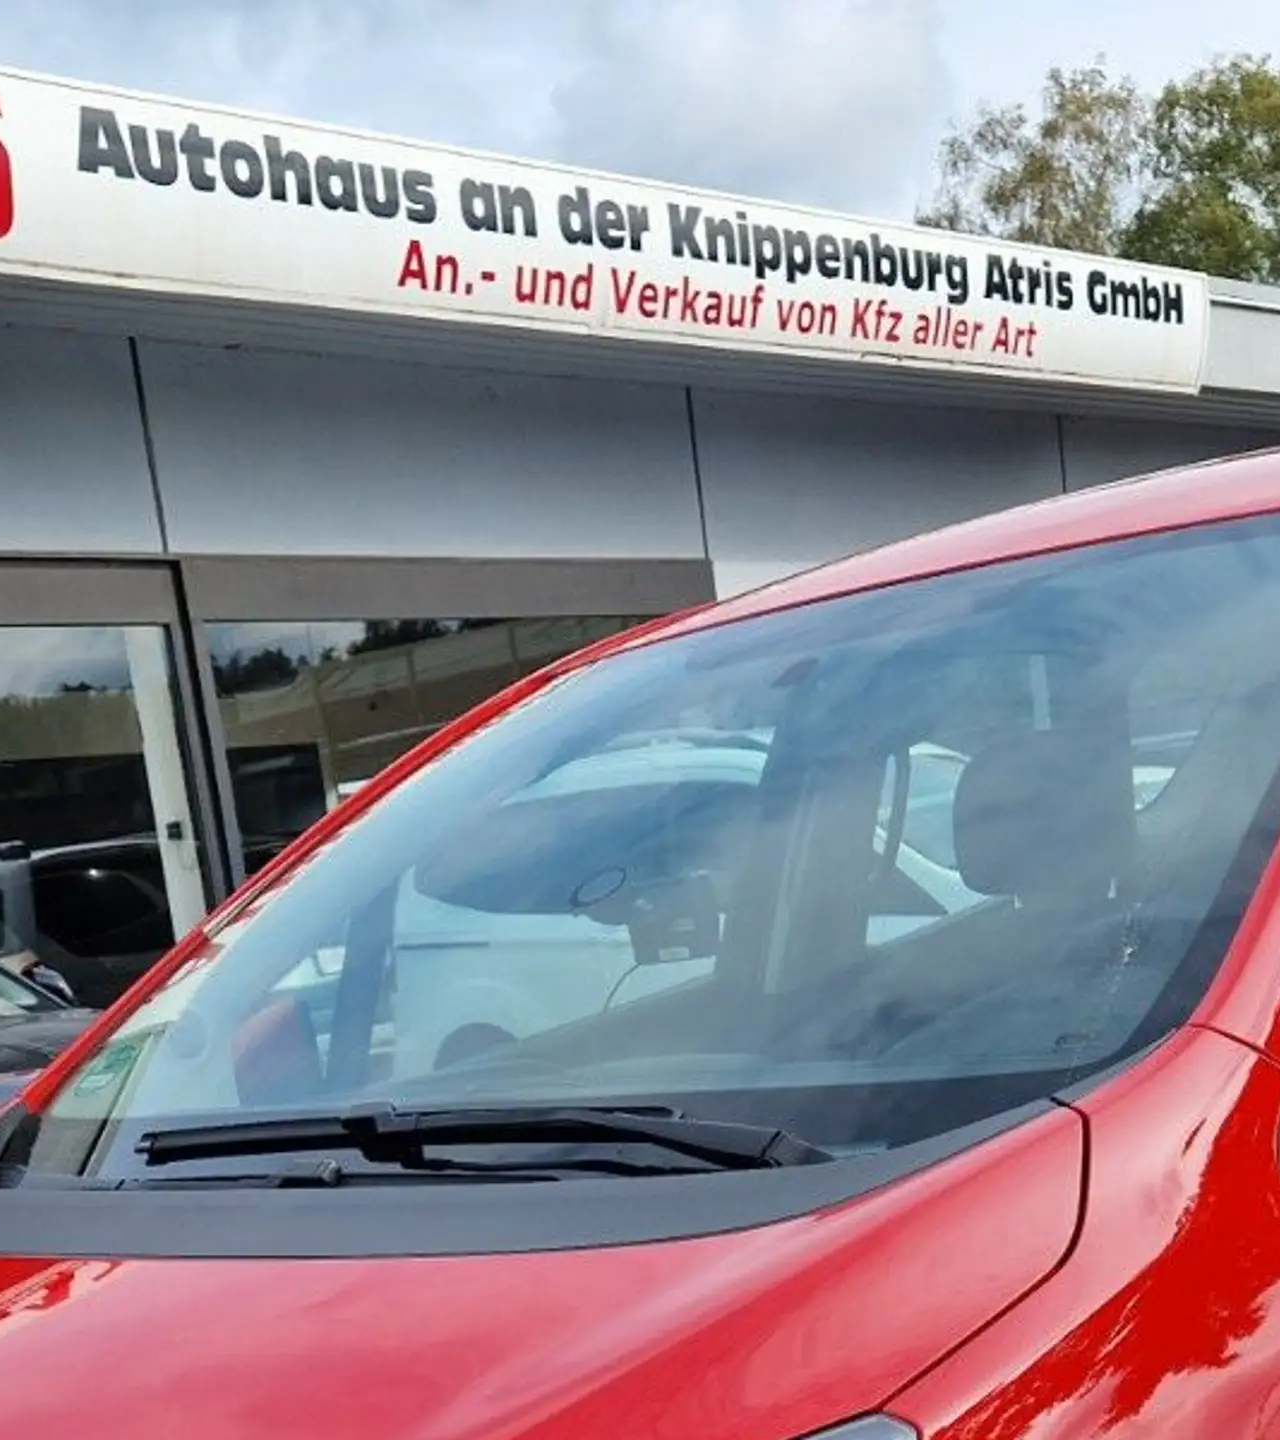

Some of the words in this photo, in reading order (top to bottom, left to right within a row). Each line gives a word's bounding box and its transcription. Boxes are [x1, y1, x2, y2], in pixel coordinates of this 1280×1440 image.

[78, 105, 438, 225] Autohaus
[460, 177, 538, 238] an
[558, 186, 650, 251] der
[668, 202, 969, 301] Knippenburg
[984, 253, 1074, 311] Atris
[1087, 269, 1184, 325] GmbH
[516, 262, 594, 311] und
[610, 266, 764, 331] Verkauf
[776, 298, 837, 336] von
[852, 298, 902, 343] Kfz
[913, 308, 985, 352] aller
[992, 317, 1038, 358] Art
